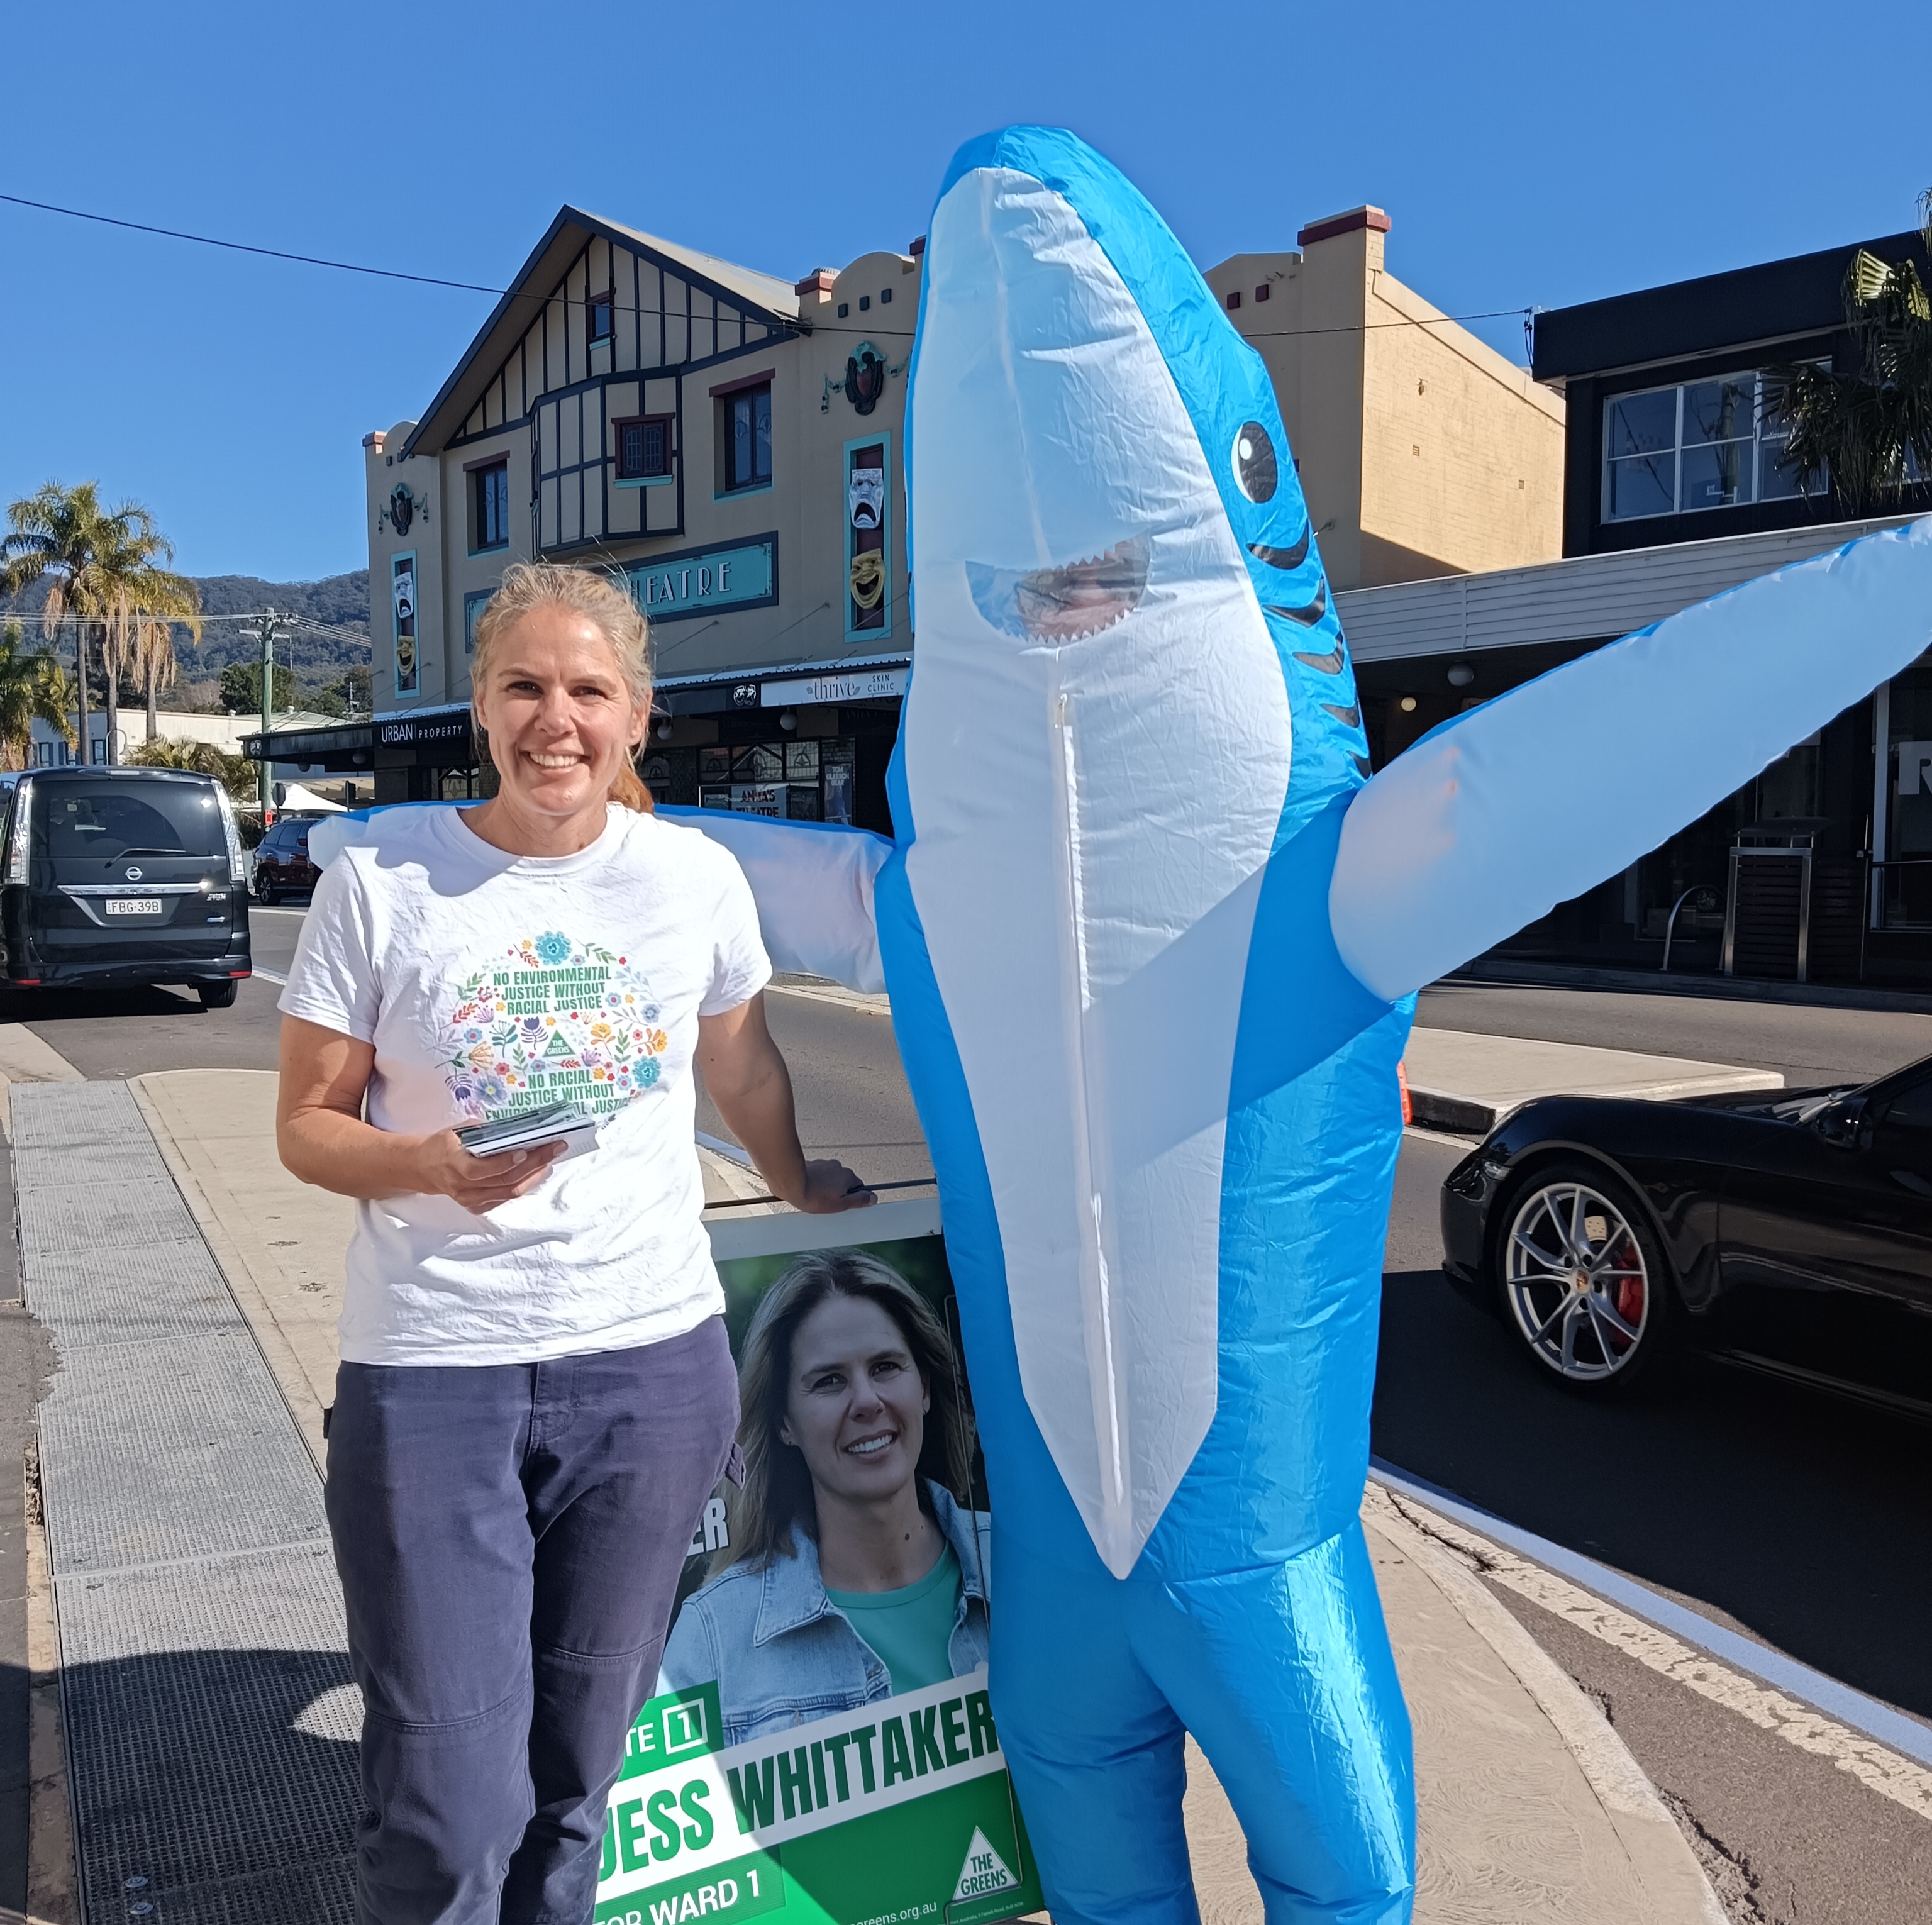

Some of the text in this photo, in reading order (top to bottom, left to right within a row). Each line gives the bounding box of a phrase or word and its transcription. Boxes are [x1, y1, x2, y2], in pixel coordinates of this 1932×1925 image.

[630, 562, 731, 604] HEATRE
[814, 676, 855, 700] thrive
[867, 683, 894, 692] CLINIC
[872, 674, 890, 683] SKIN
[381, 723, 462, 743] URBAN PROPERTY
[493, 966, 612, 985] NO ENVIRONMENTAL
[501, 982, 605, 1001] JUSTICE WITHOUT
[507, 996, 602, 1015] RACIAL JUSTICE
[547, 1046, 570, 1055] GREENS
[528, 1069, 593, 1089] NO RACIAL
[508, 1084, 615, 1107] JUSTICE WITHOUT
[626, 1710, 691, 1757] TE 1
[599, 1689, 999, 1882] JESS WHITTAKER
[970, 1853, 994, 1873] THE
[960, 1868, 1008, 1896] GREENS
[649, 1868, 759, 1925] WARD 1
